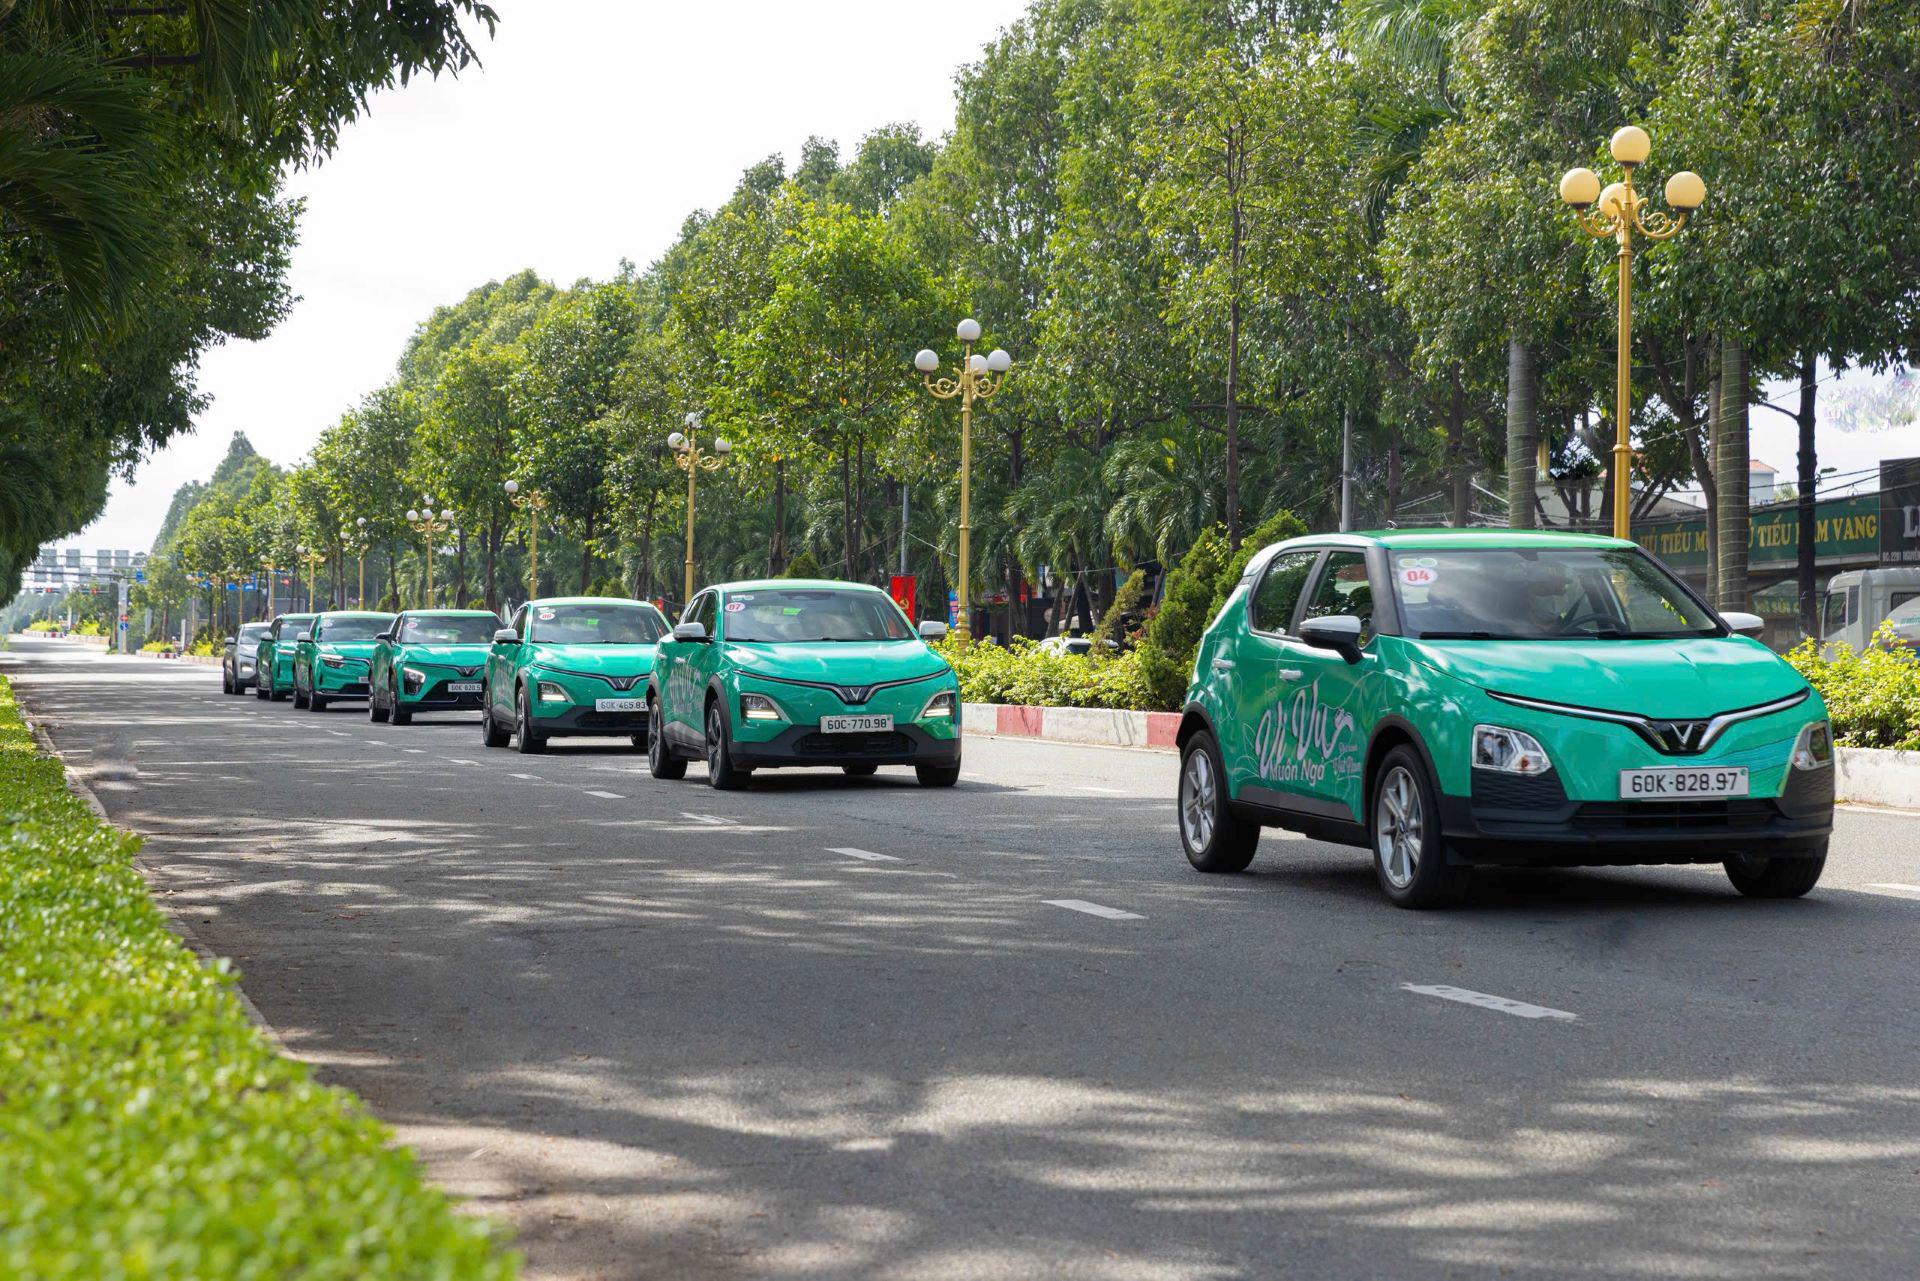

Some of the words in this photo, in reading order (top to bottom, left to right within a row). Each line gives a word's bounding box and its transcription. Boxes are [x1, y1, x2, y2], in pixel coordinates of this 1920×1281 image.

[1661, 523, 1692, 554] TIẾU
[1757, 513, 1792, 548] TIẾU
[1831, 515, 1877, 541] VANG
[1407, 570, 1430, 582] 04
[827, 718, 887, 730] 60C-770.98
[1632, 772, 1738, 793] 60K-828.97
